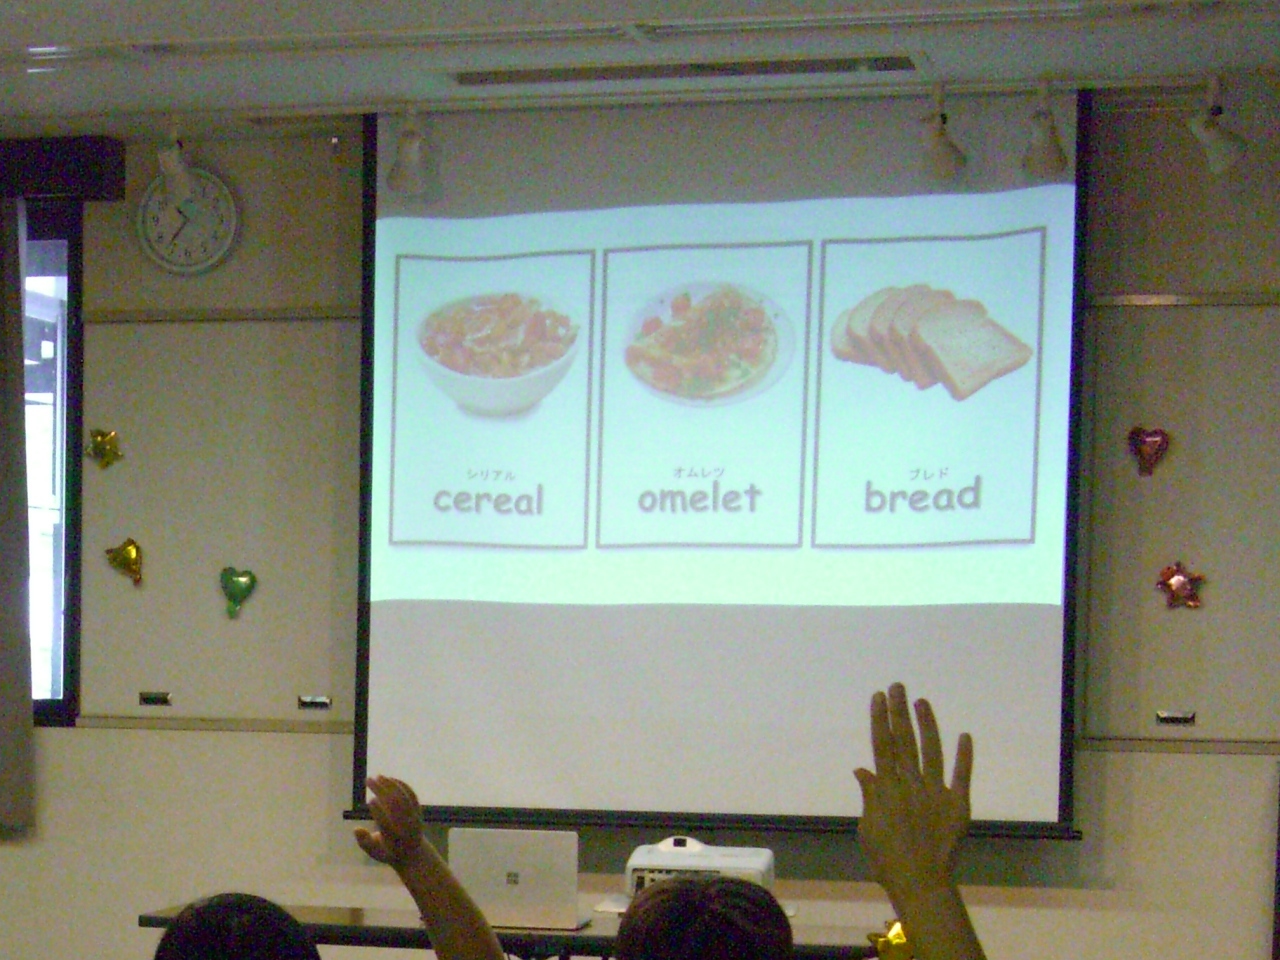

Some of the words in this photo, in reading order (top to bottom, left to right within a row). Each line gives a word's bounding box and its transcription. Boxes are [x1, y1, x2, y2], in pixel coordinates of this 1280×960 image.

[673, 466, 725, 479] オムレツ
[433, 483, 544, 516] cereal
[638, 479, 762, 513] omelet
[865, 474, 982, 513] bread
